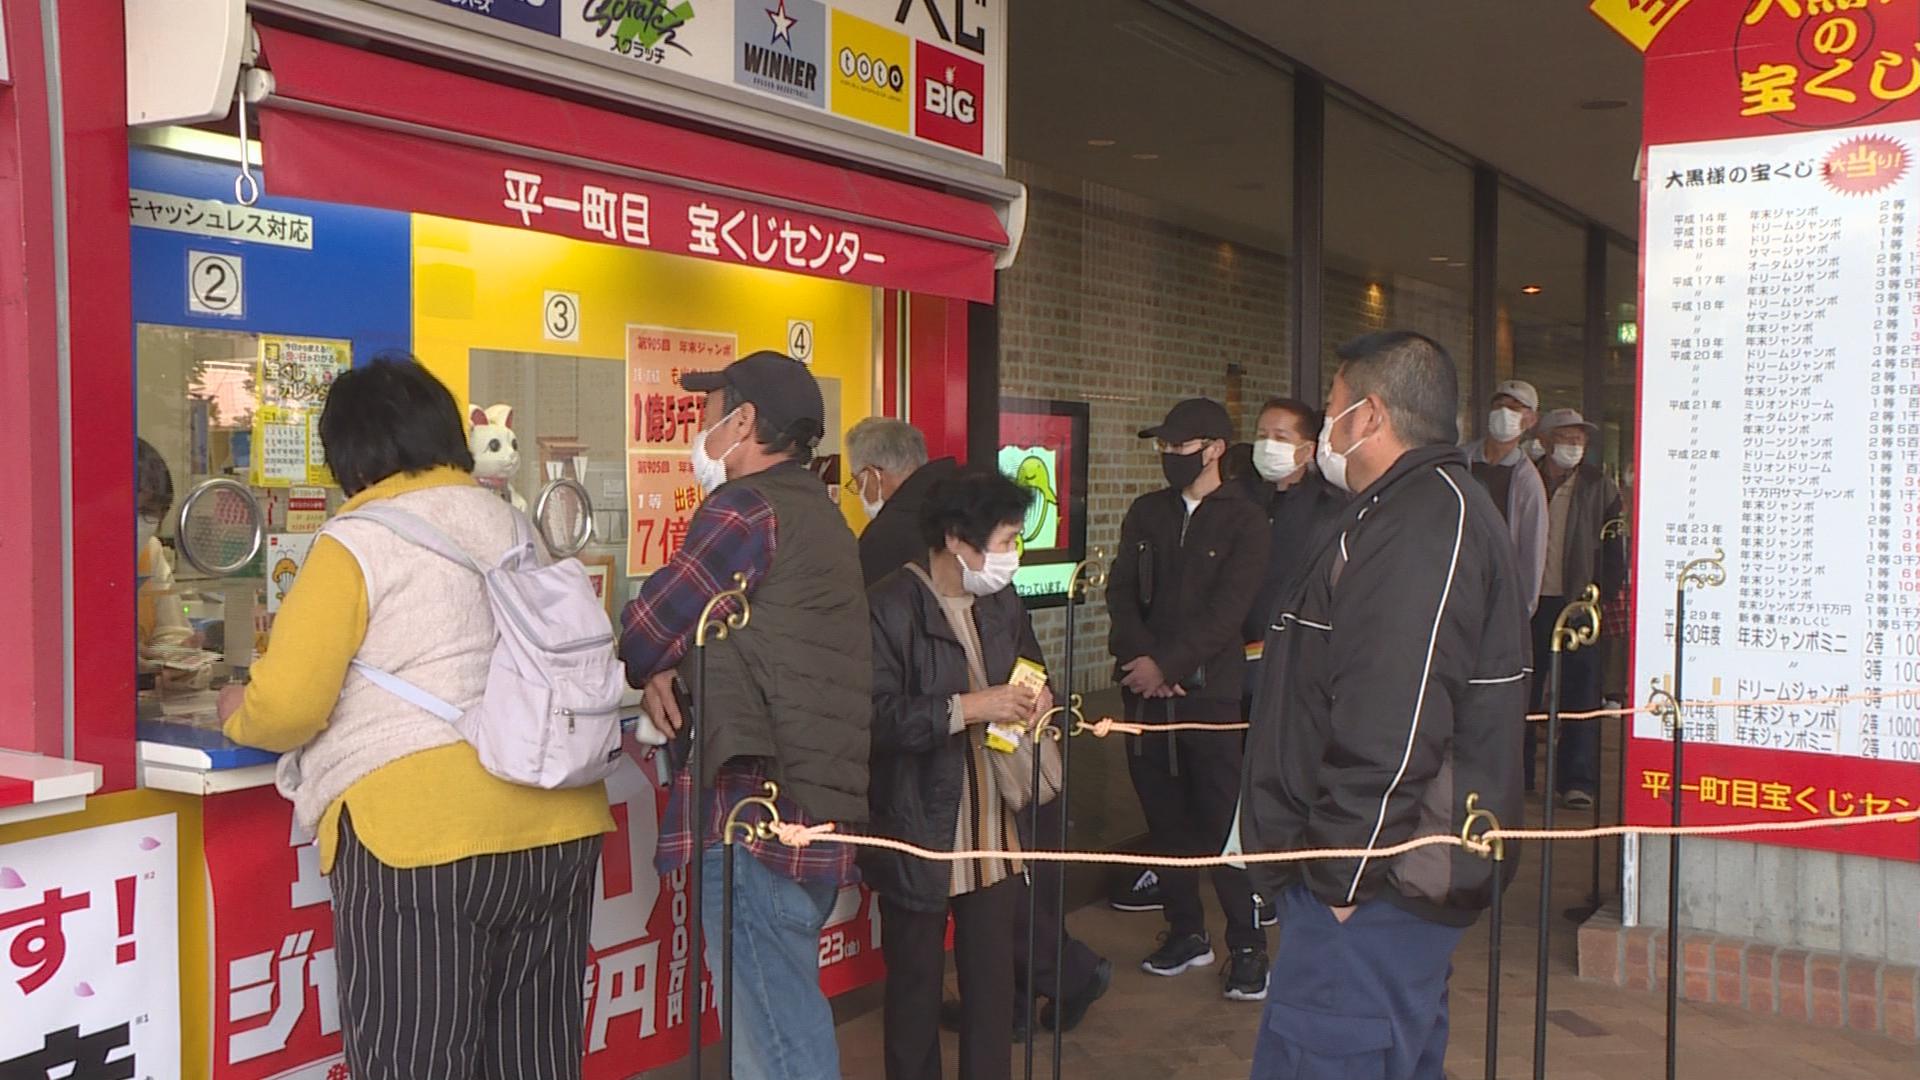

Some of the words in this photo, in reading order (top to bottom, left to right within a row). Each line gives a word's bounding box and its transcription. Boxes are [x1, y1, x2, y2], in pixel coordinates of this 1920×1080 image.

[1813, 17, 1858, 54] の
[610, 34, 665, 64] スクラッチ
[744, 42, 817, 91] WINNER
[839, 47, 904, 92] toto
[925, 76, 975, 124] BIG
[1664, 159, 1815, 189] 大黒様の宝くじ
[1749, 207, 1819, 220] 年末ジャンボ
[503, 169, 650, 246] 平一町目
[688, 203, 885, 275] 宝くじセンター
[1750, 217, 1842, 233] ドリームジャンボ
[1750, 231, 1841, 246] ドリームジャンボ
[1749, 244, 1828, 258] サマージャンボ
[1748, 256, 1840, 271] オータムジャンボ
[1748, 270, 1839, 284] ドリームジャンボ
[1747, 283, 1815, 296] 年末ジャンボ
[1748, 296, 1838, 309] ドリームジャンボ
[1747, 309, 1826, 321] サマージャンボ
[1746, 322, 1813, 334] 年末ジャンボ
[1746, 335, 1813, 346] 年末ジャンボ
[679, 340, 732, 357] 年末ジャンボ
[1746, 347, 1836, 359] ドリームジャンボ
[1746, 360, 1836, 372] ドリームジャンボ
[1745, 372, 1824, 384] サマージャンボ
[1744, 386, 1811, 397] 年末ジャンボ
[1744, 399, 1834, 411] ミリオンドリーム
[1744, 411, 1834, 422] オータムジャンボ
[1743, 424, 1810, 435] 年末ジャンボ
[1743, 437, 1833, 448] グリーンジャンボ
[1743, 450, 1833, 461] ドリームジャンボ
[1742, 463, 1832, 474] ミリオンドリーム
[1742, 475, 1821, 486] サマージャンボ
[1742, 488, 1855, 499] 1千万円サマージャンボ
[1742, 500, 1815, 511] 年末ジャンボ
[1742, 513, 1815, 524] 年末ジャンボ
[1741, 525, 1814, 537] 年末ジャンボ
[1741, 537, 1814, 549] 年末ジャンボ
[1740, 550, 1813, 562] 年末ジャンボ
[1740, 563, 1826, 576] サマージャンボ
[1739, 576, 1812, 588] 年末ジャンボ
[1739, 588, 1812, 600] 年末ジャンボ
[1665, 609, 1721, 621] 平29年
[1664, 623, 1721, 646] 平30年度
